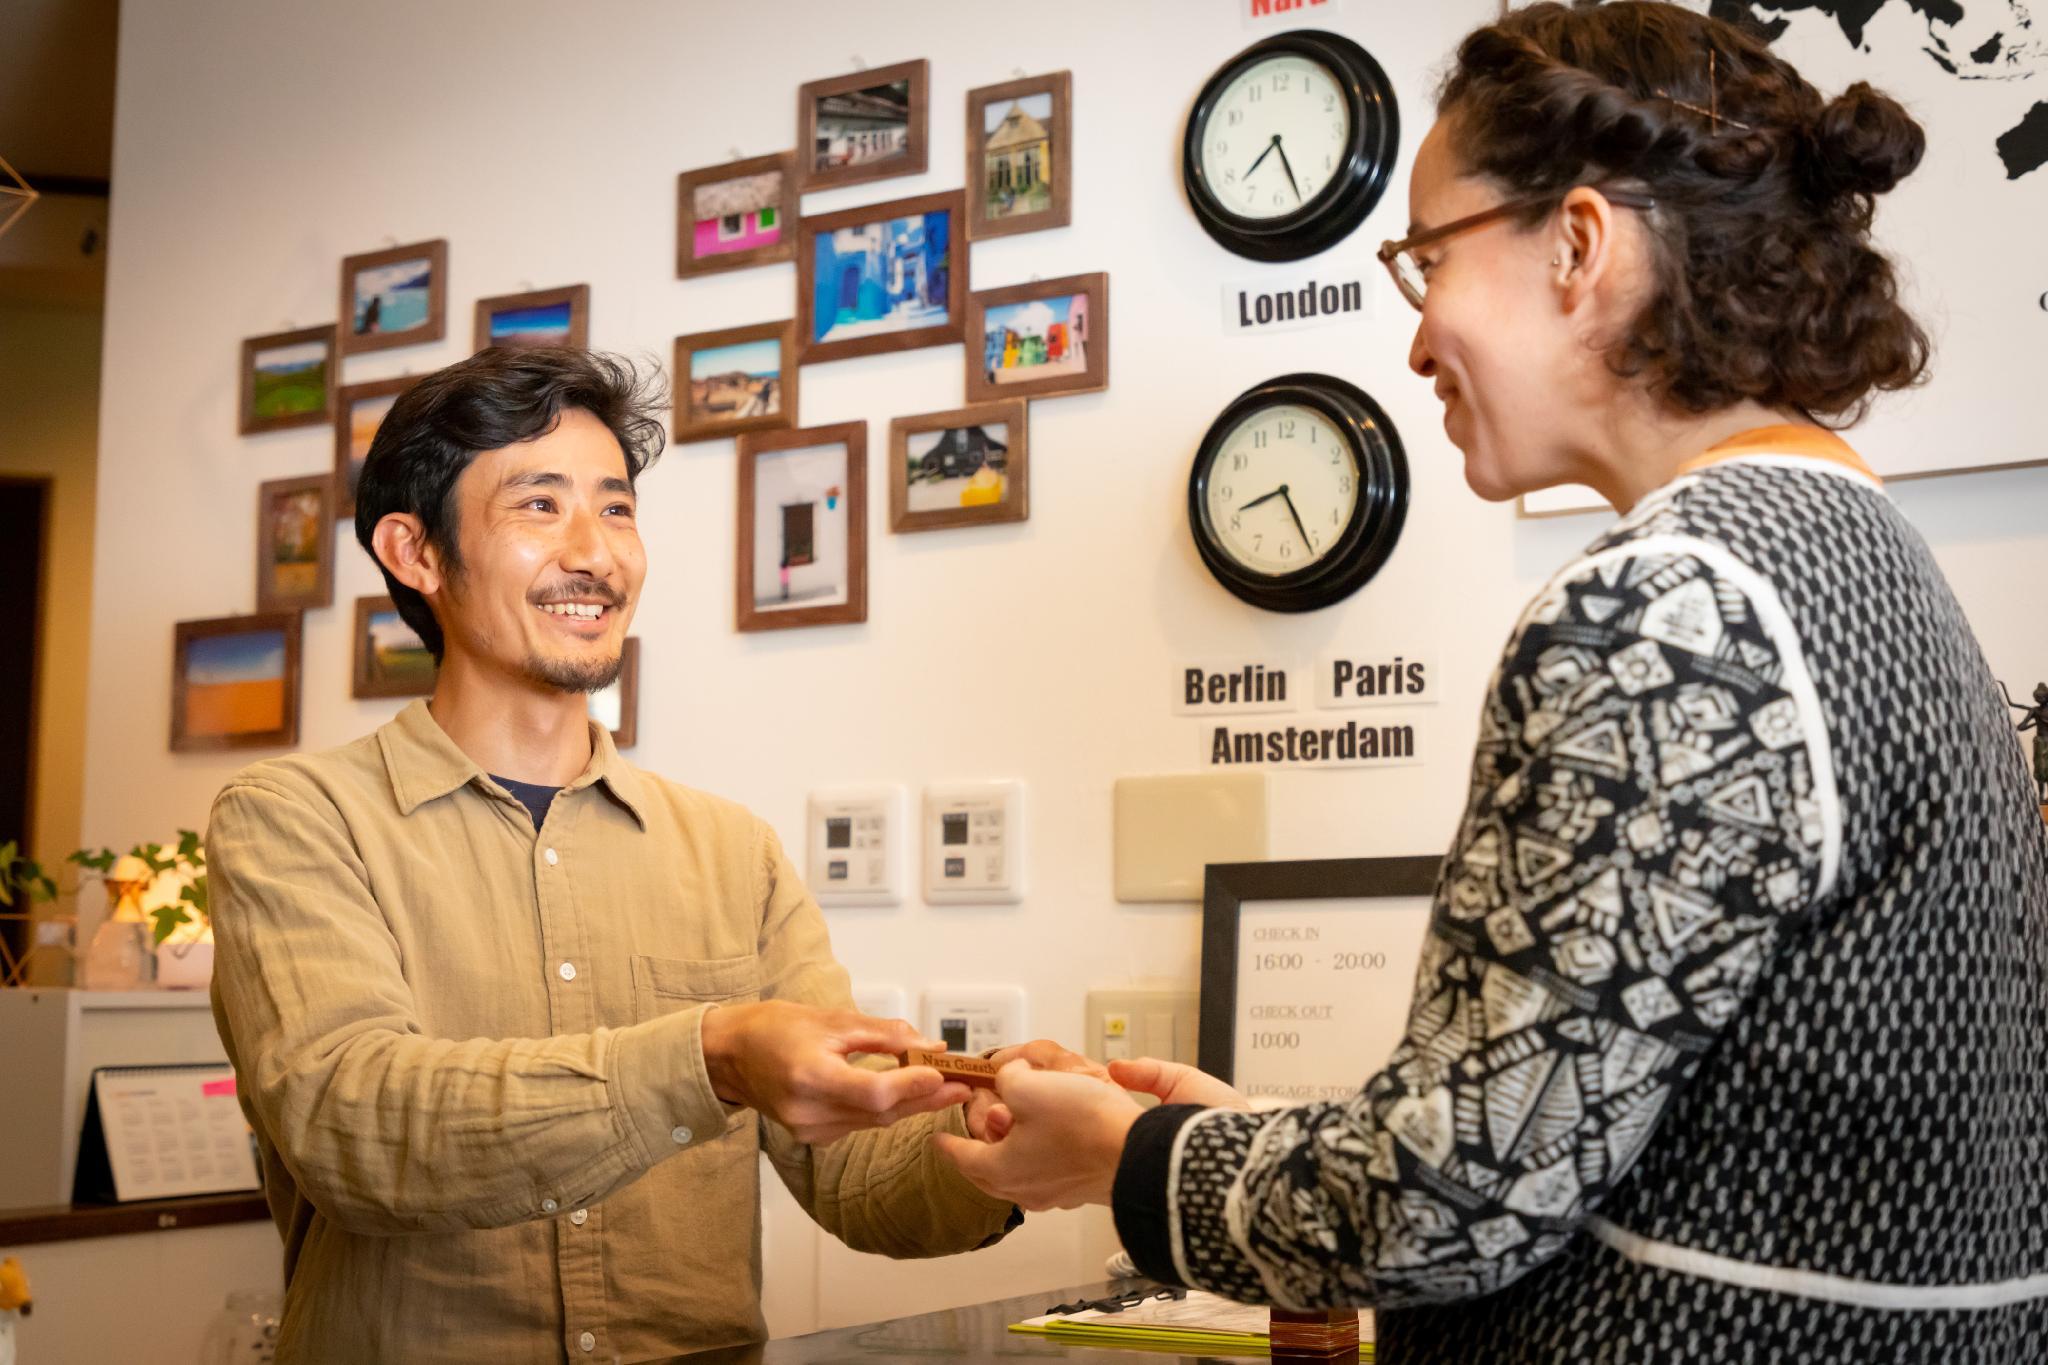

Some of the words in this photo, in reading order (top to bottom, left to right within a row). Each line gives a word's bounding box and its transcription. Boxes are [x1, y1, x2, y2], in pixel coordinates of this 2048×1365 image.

[1238, 281, 1361, 327] London
[1277, 421, 1295, 439] 12
[1233, 454, 1248, 471] 10
[1331, 447, 1341, 465] 2
[1185, 665, 1287, 704] Berlin
[1334, 657, 1425, 698] Paris
[1211, 721, 1414, 764] Amsterdam
[1253, 927, 1300, 941] CHECK
[1304, 926, 1320, 940] IN
[1333, 951, 1386, 970] 20:00
[1250, 1006, 1297, 1019] CHECK
[1301, 1005, 1333, 1018] OUT
[922, 1053, 951, 1068] Nara
[954, 1058, 999, 1075] Guesth
[1246, 1084, 1315, 1098] LUGGAGE
